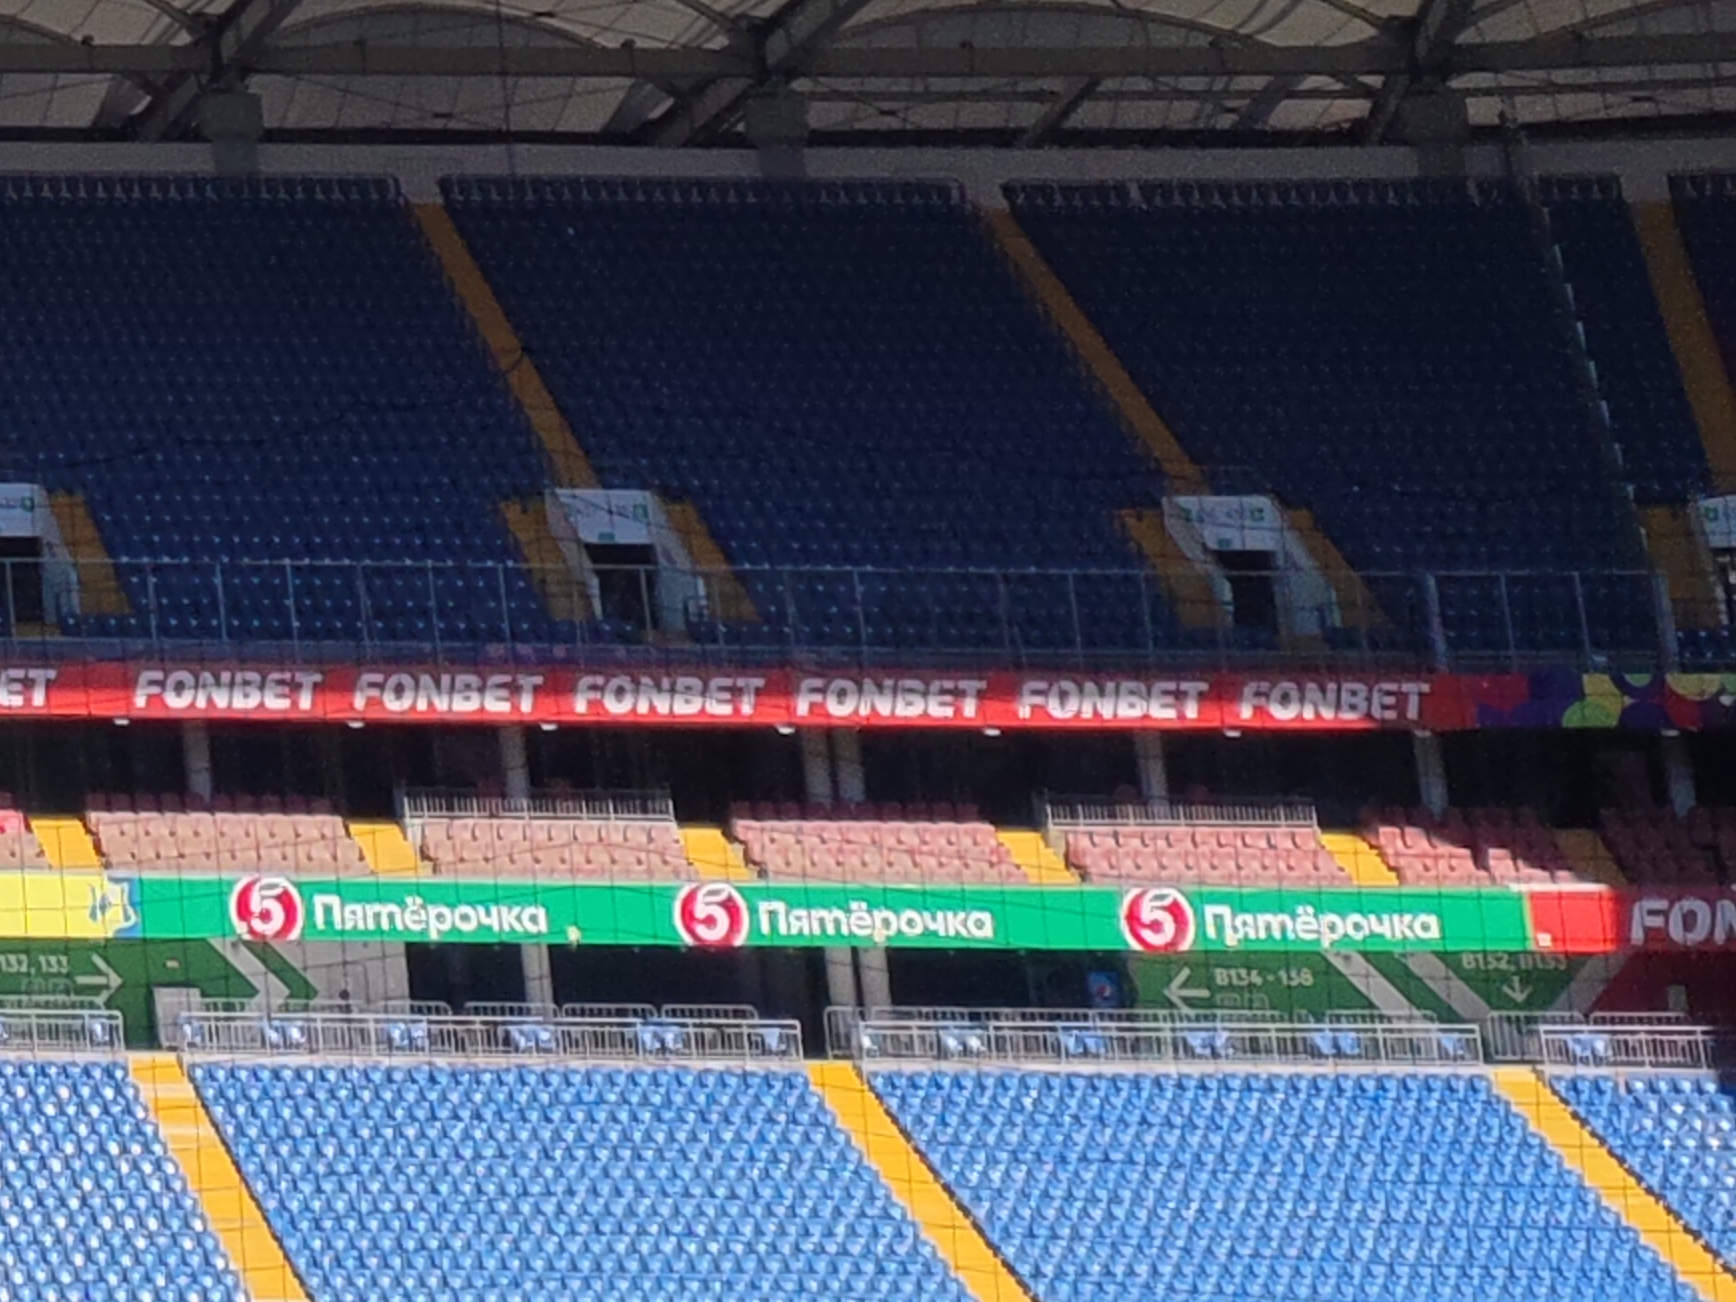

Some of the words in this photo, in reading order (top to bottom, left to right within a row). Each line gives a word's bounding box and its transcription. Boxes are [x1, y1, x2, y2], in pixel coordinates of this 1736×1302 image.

[132, 669, 323, 711] FONBET
[352, 672, 544, 713] FONBET
[572, 674, 765, 716] FONBET
[795, 677, 988, 718] FONBET
[1017, 680, 1209, 720] FONBET
[1237, 681, 1431, 722] FONBET
[313, 893, 548, 941] Пятёрочка
[757, 900, 993, 948] Пятёрочка
[1204, 906, 1440, 949] Пятёрочка
